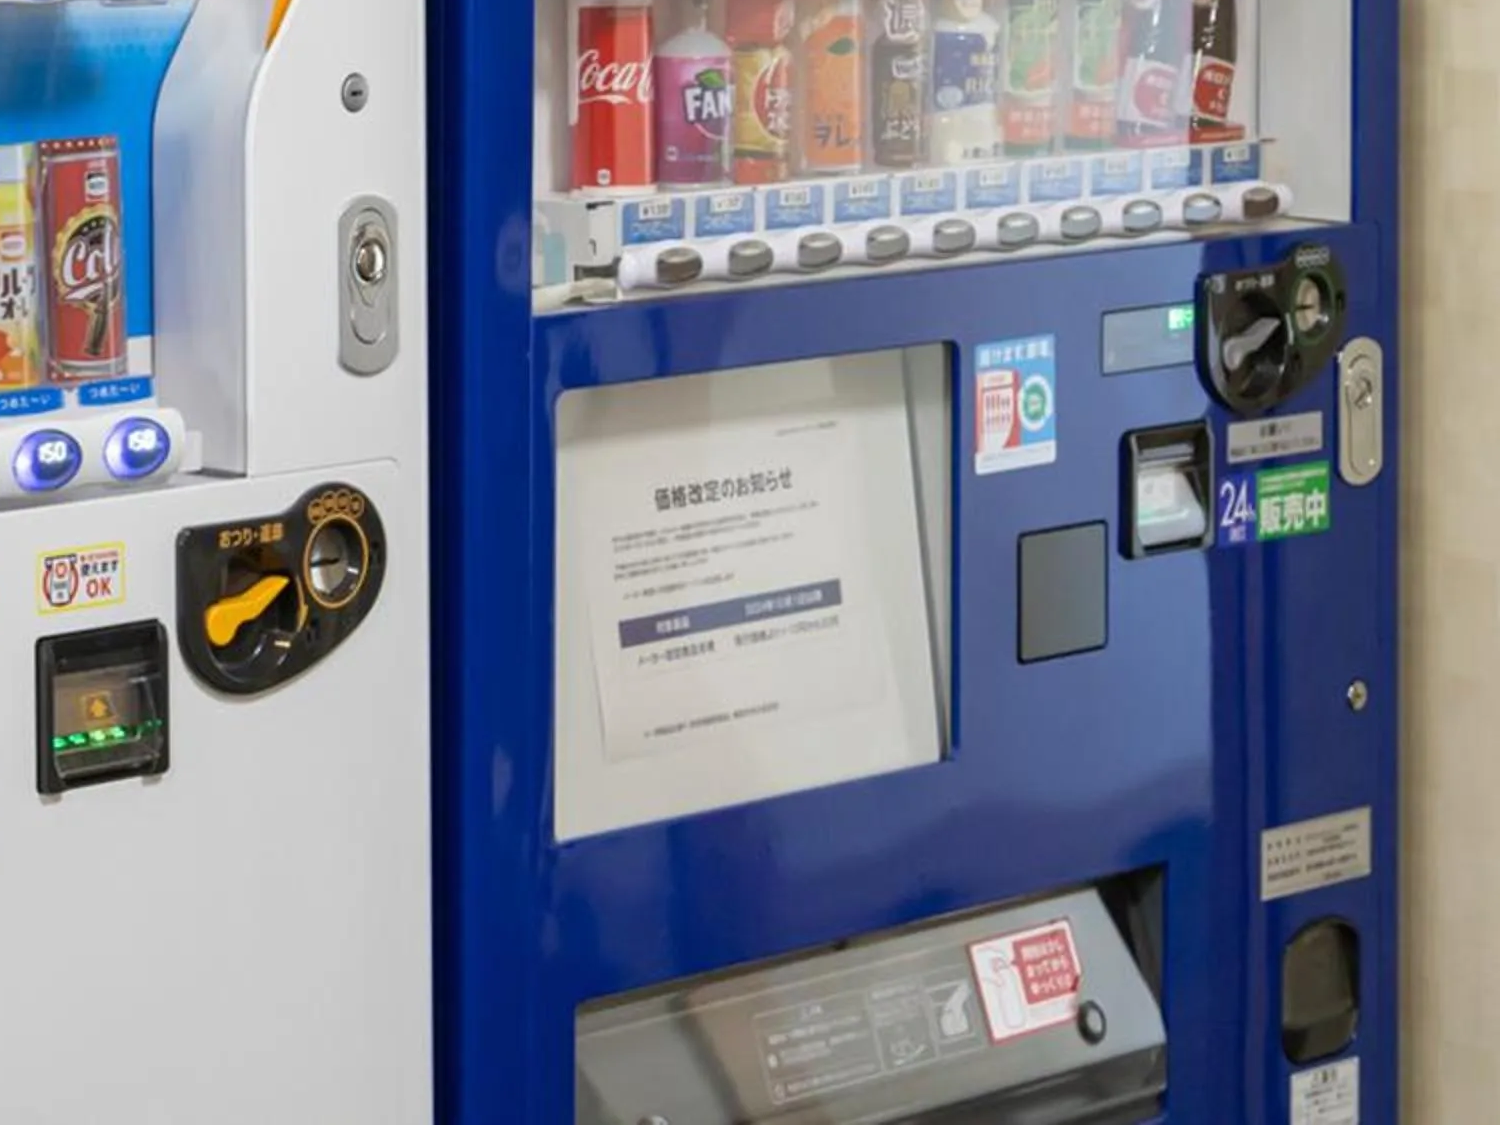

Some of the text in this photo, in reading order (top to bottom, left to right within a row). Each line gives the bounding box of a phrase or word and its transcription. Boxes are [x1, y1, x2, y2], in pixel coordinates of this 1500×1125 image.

[39, 441, 67, 463] 150
[654, 466, 794, 513] 価格改定のお知らせ
[1259, 488, 1327, 535] 販売中
[86, 576, 112, 598] OK
